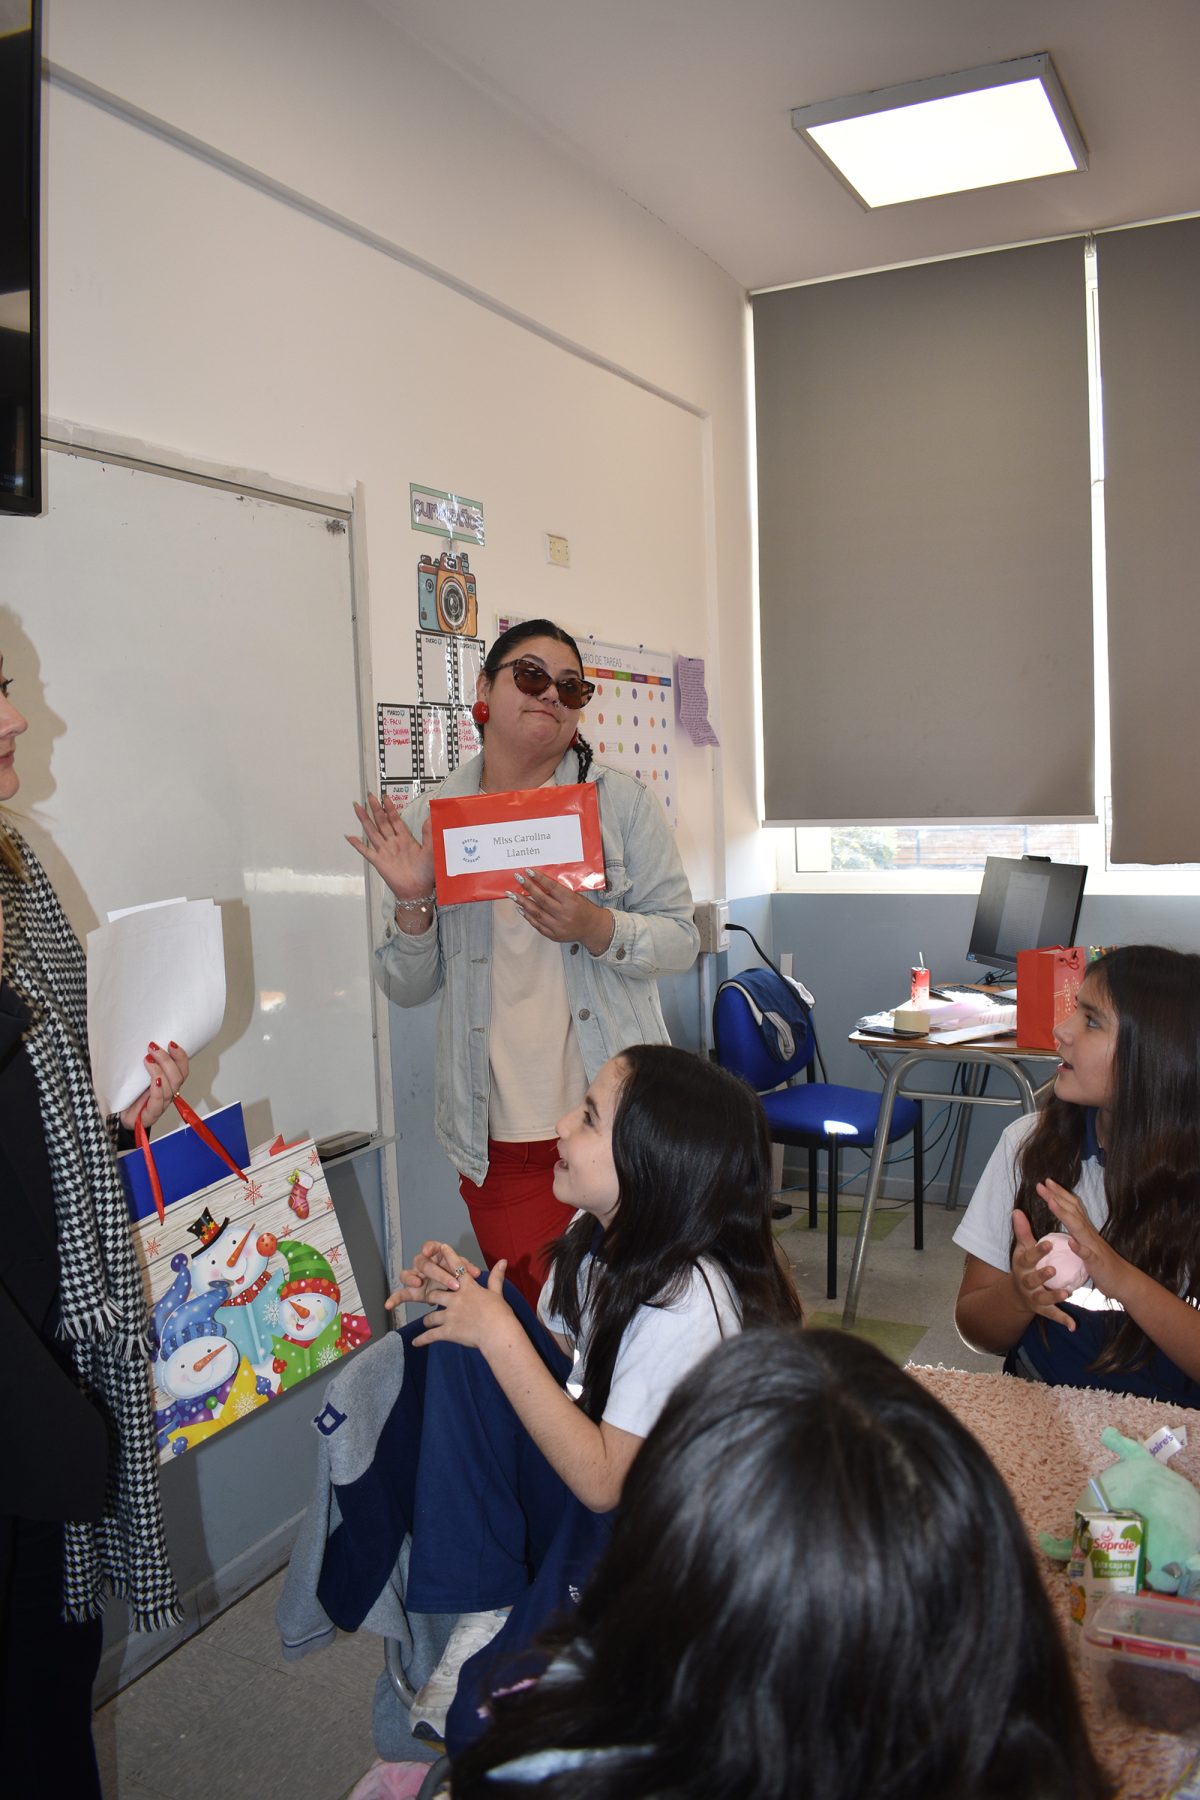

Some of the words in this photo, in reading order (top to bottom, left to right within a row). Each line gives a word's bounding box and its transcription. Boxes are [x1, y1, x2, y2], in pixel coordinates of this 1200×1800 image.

[493, 836, 513, 846] Miss
[514, 832, 551, 844] Carolina
[506, 847, 541, 858] Llantén
[1093, 1538, 1135, 1552] Soprole
